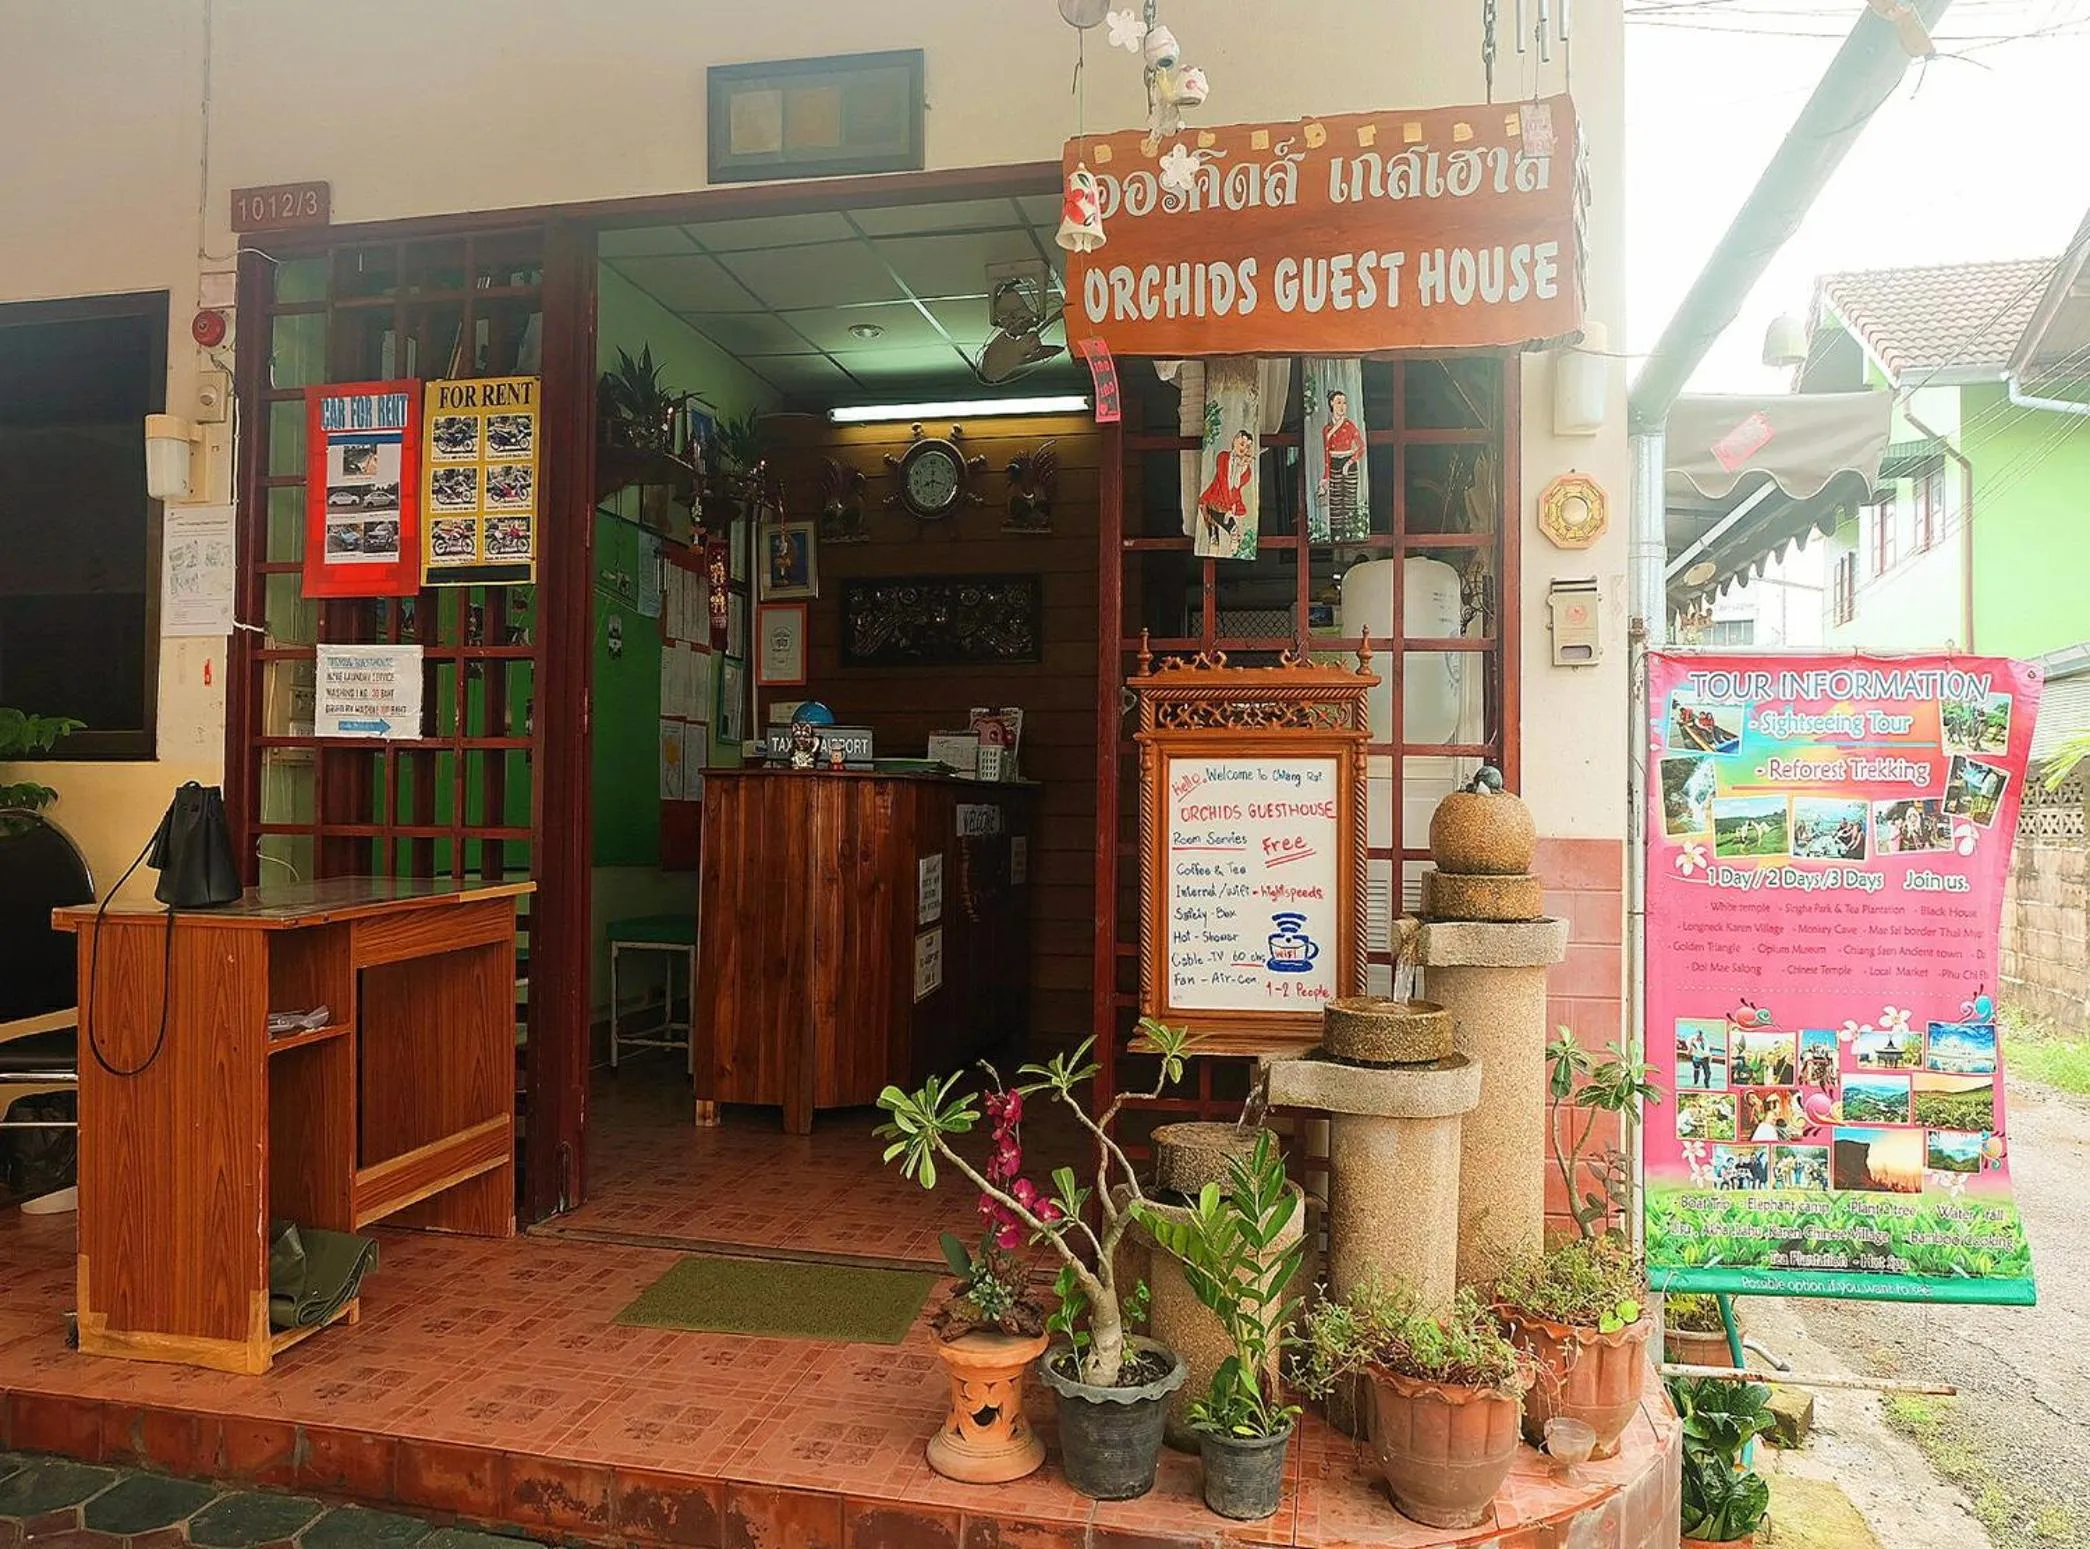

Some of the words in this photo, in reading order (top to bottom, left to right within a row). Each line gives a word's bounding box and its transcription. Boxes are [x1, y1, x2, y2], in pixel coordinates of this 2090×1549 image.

[238, 191, 318, 221] 1012/3
[1083, 257, 1258, 325] ORCHIDS
[1274, 250, 1405, 314] GUEST
[1418, 241, 1559, 307] HOUSE
[440, 386, 478, 409] FOR
[481, 383, 534, 407] RENT
[322, 398, 346, 430] CAR
[351, 396, 372, 429] FOR
[378, 394, 407, 428] RENT
[1690, 672, 1771, 698] TOUR
[1780, 671, 1990, 700] INFORMATION
[1761, 711, 1862, 737] Sightseeing
[1868, 712, 1911, 734] Tour
[820, 738, 868, 754] AIORT
[1206, 765, 1253, 781] Welcome
[1769, 759, 1844, 780] Reforest
[1851, 759, 1928, 786] Trekking
[1181, 804, 1242, 822] ORCHIDS
[1248, 801, 1338, 820] GUESTHOUSE
[1172, 831, 1201, 845] Room
[1262, 836, 1307, 855] Free
[1176, 862, 1211, 876] Coffee
[1846, 871, 1883, 892] Days
[1905, 870, 1941, 889] Join
[1710, 901, 1737, 912] White
[1862, 904, 1905, 914] Plantation
[1920, 905, 1945, 917] Black
[1174, 930, 1191, 944] Hot
[1726, 923, 1752, 933] Karen
[1754, 922, 1785, 937] Village
[1834, 923, 1858, 935] Cave
[1904, 926, 1936, 937] border
[1171, 951, 1204, 968] Cable
[1233, 950, 1246, 961] 60
[1672, 940, 1704, 951] Golden
[1843, 944, 1875, 958] Chiang
[1936, 948, 1963, 959] town
[1174, 972, 1195, 986] Fan
[1691, 962, 1707, 972] Doi
[1710, 962, 1730, 973] Mae
[1819, 964, 1852, 976] Temple
[1869, 966, 1891, 977] Local
[1895, 966, 1928, 977] Market
[1942, 968, 1960, 979] Phu
[1681, 1195, 1706, 1209] Boat
[1711, 1197, 1730, 1211] Trip
[1748, 1197, 1795, 1212] Elephant
[1799, 1201, 1830, 1214] camp
[1851, 1200, 1880, 1213] Plant
[1894, 1205, 1917, 1216] tree
[1936, 1204, 1973, 1220] Water
[1804, 1225, 1846, 1239] Chinese
[1854, 1226, 1889, 1244] Village
[1911, 1230, 1960, 1245] Bamboo
[1964, 1235, 2013, 1251] Cooking
[1790, 1251, 1848, 1268] Plantation
[1861, 1254, 1886, 1268] Hot
[1888, 1255, 1909, 1271] Spa
[1743, 1276, 1784, 1290] Possible
[1787, 1279, 1825, 1294] option
[1828, 1279, 1835, 1292] if
[1836, 1281, 1858, 1295] you
[1859, 1282, 1894, 1294] want
[1896, 1283, 1909, 1295] to
